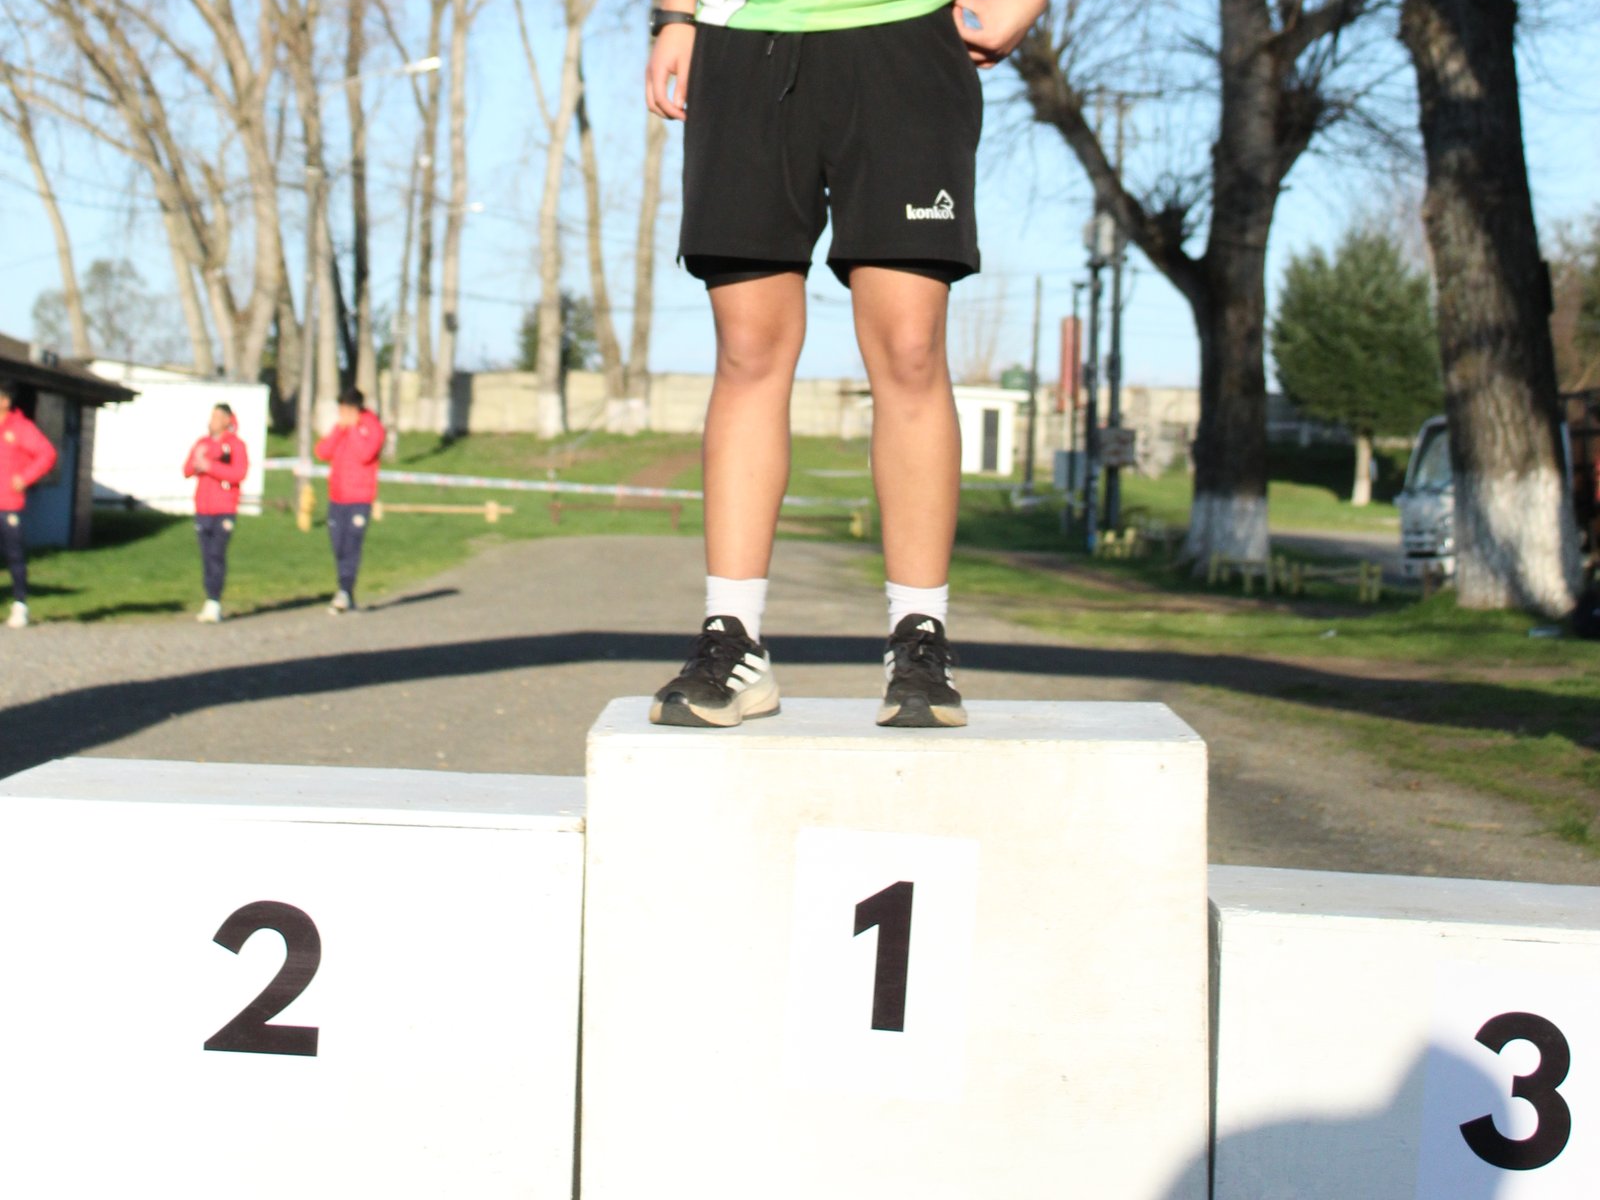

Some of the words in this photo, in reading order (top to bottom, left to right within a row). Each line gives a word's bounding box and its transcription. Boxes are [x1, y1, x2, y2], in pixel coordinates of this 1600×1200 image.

[203, 900, 322, 1057] 2
[853, 881, 914, 1033] 1
[1459, 1012, 1572, 1171] 3
